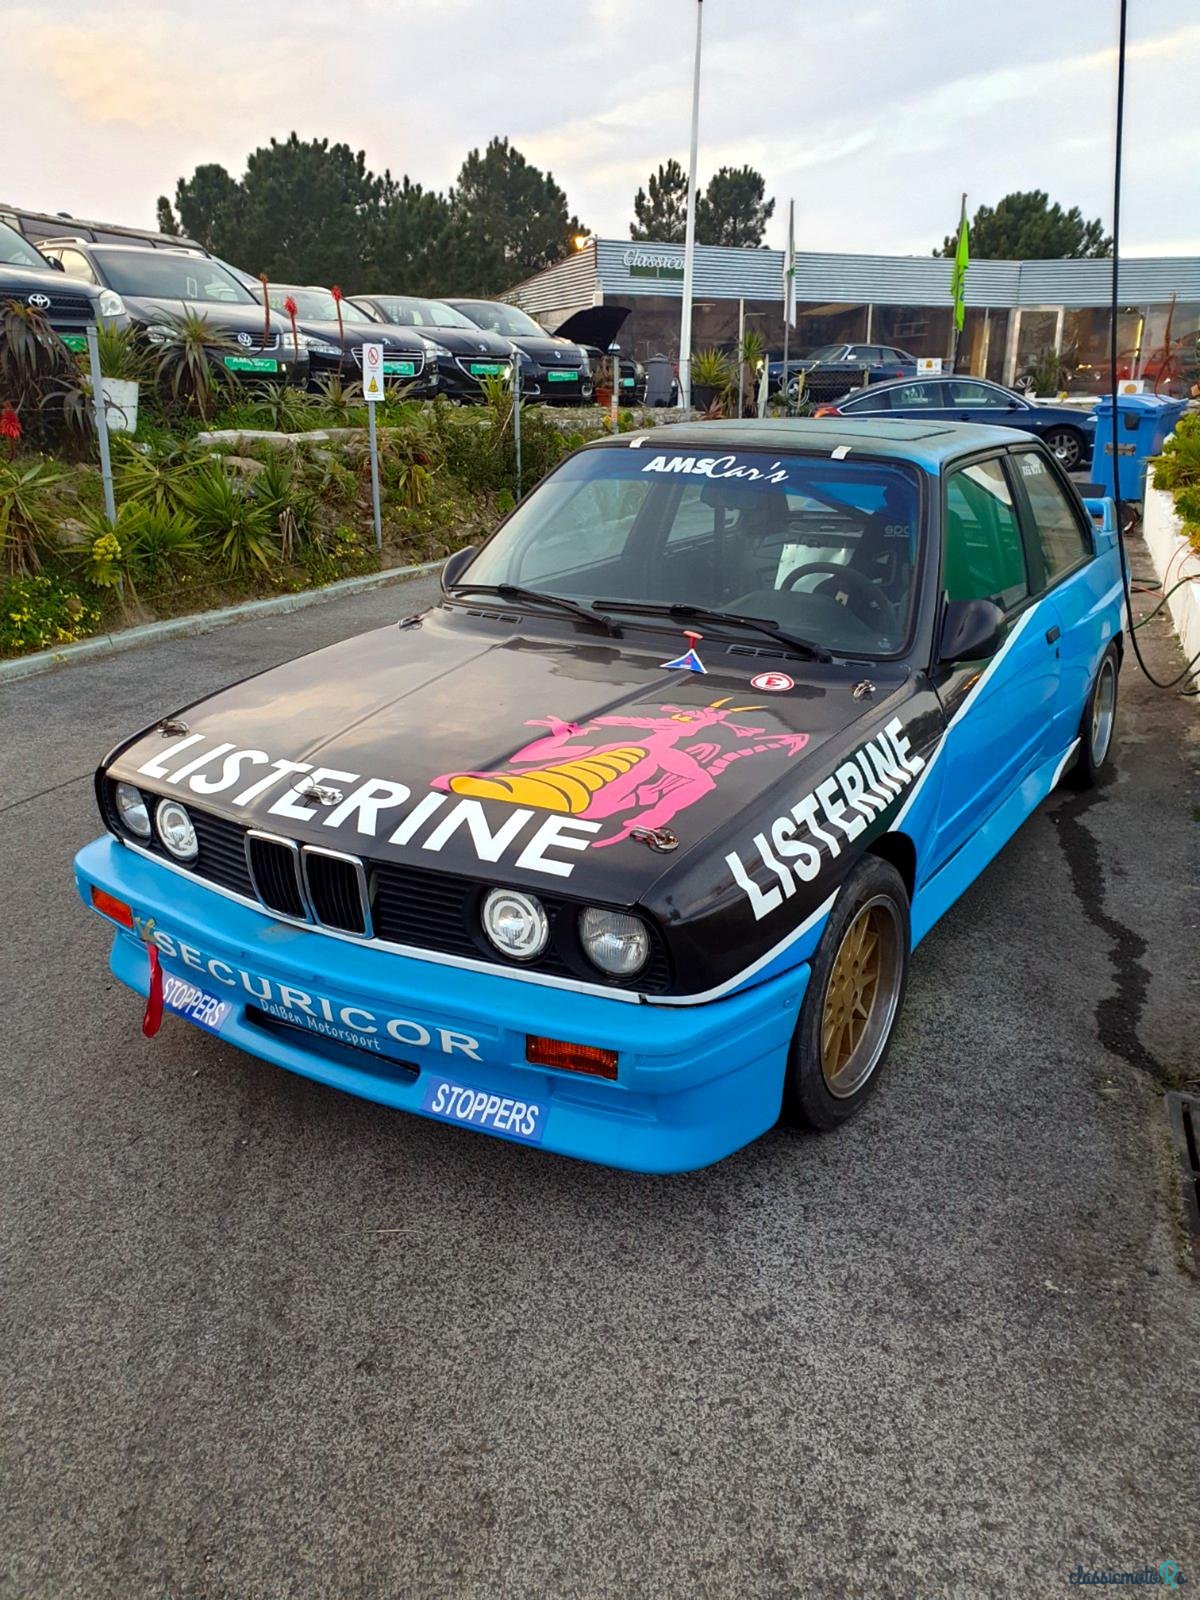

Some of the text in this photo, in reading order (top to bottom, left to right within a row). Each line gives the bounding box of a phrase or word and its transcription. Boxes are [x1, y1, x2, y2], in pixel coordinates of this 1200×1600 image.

[765, 677, 784, 687] E
[137, 733, 606, 879] LISTERINE
[724, 716, 927, 921] LISTERINE
[153, 931, 485, 1062] SECURICOR
[163, 977, 226, 1027] STOPPERS
[306, 1014, 382, 1051] Motorsport
[431, 1083, 540, 1136] STOPPERS
